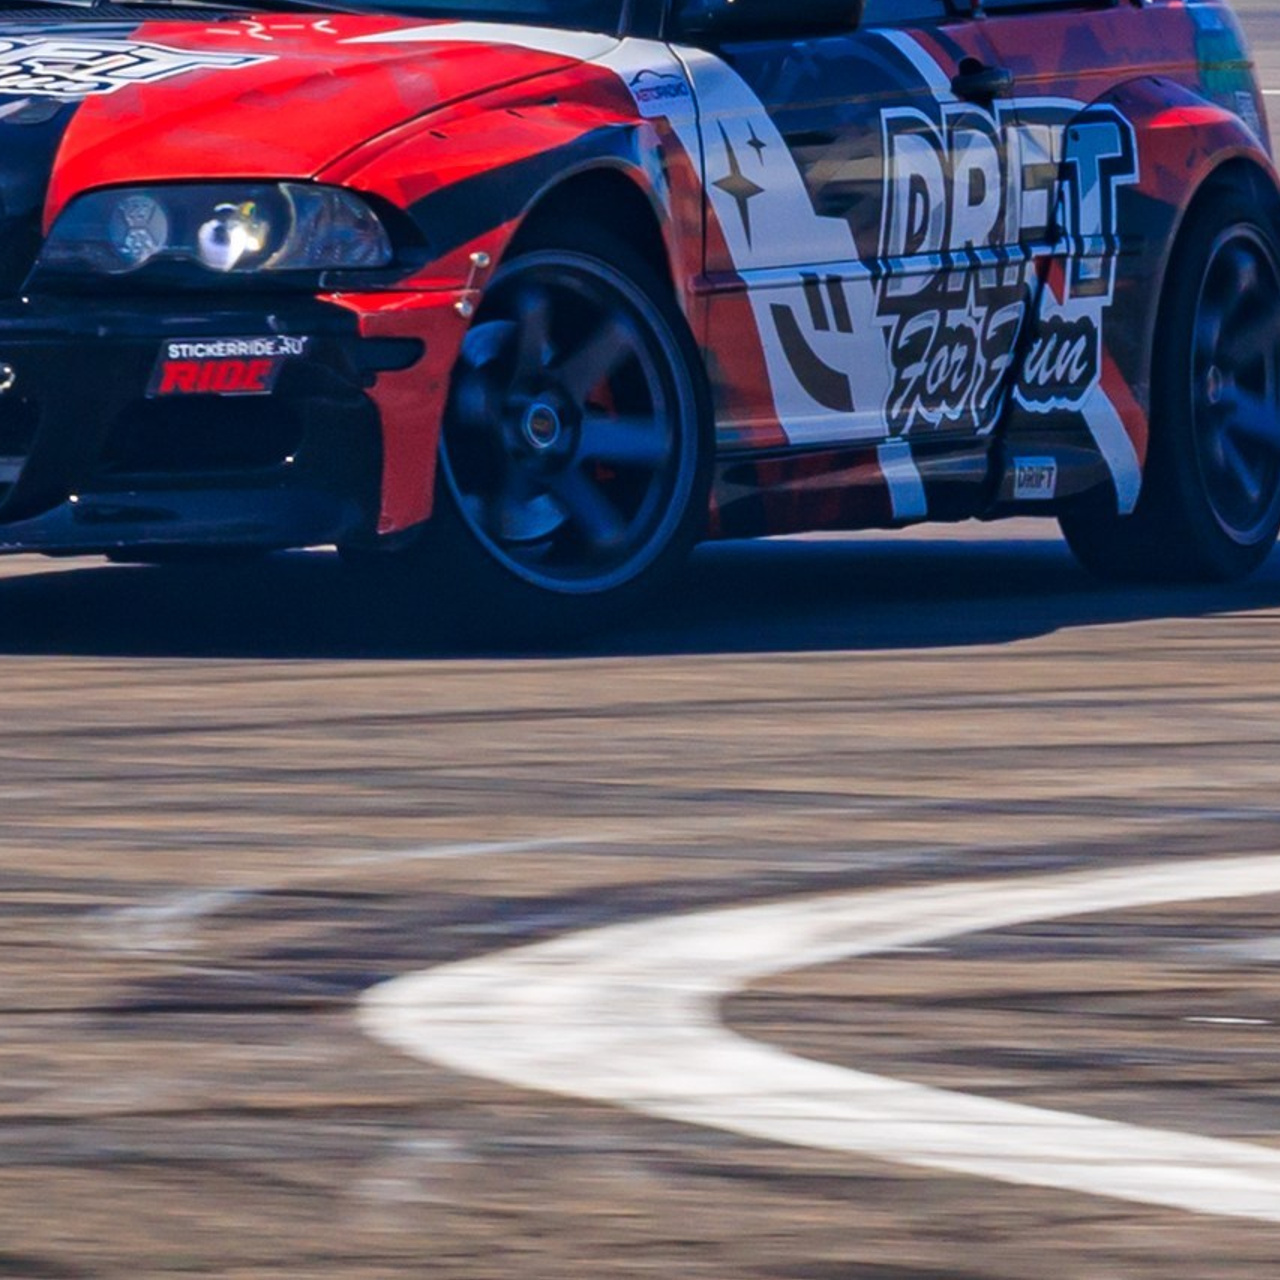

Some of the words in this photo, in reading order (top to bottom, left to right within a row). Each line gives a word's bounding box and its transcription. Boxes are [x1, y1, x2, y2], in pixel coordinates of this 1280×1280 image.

[168, 334, 308, 358] STICKERRIDE.RU
[159, 359, 274, 394] RIDE
[888, 308, 970, 420] For
